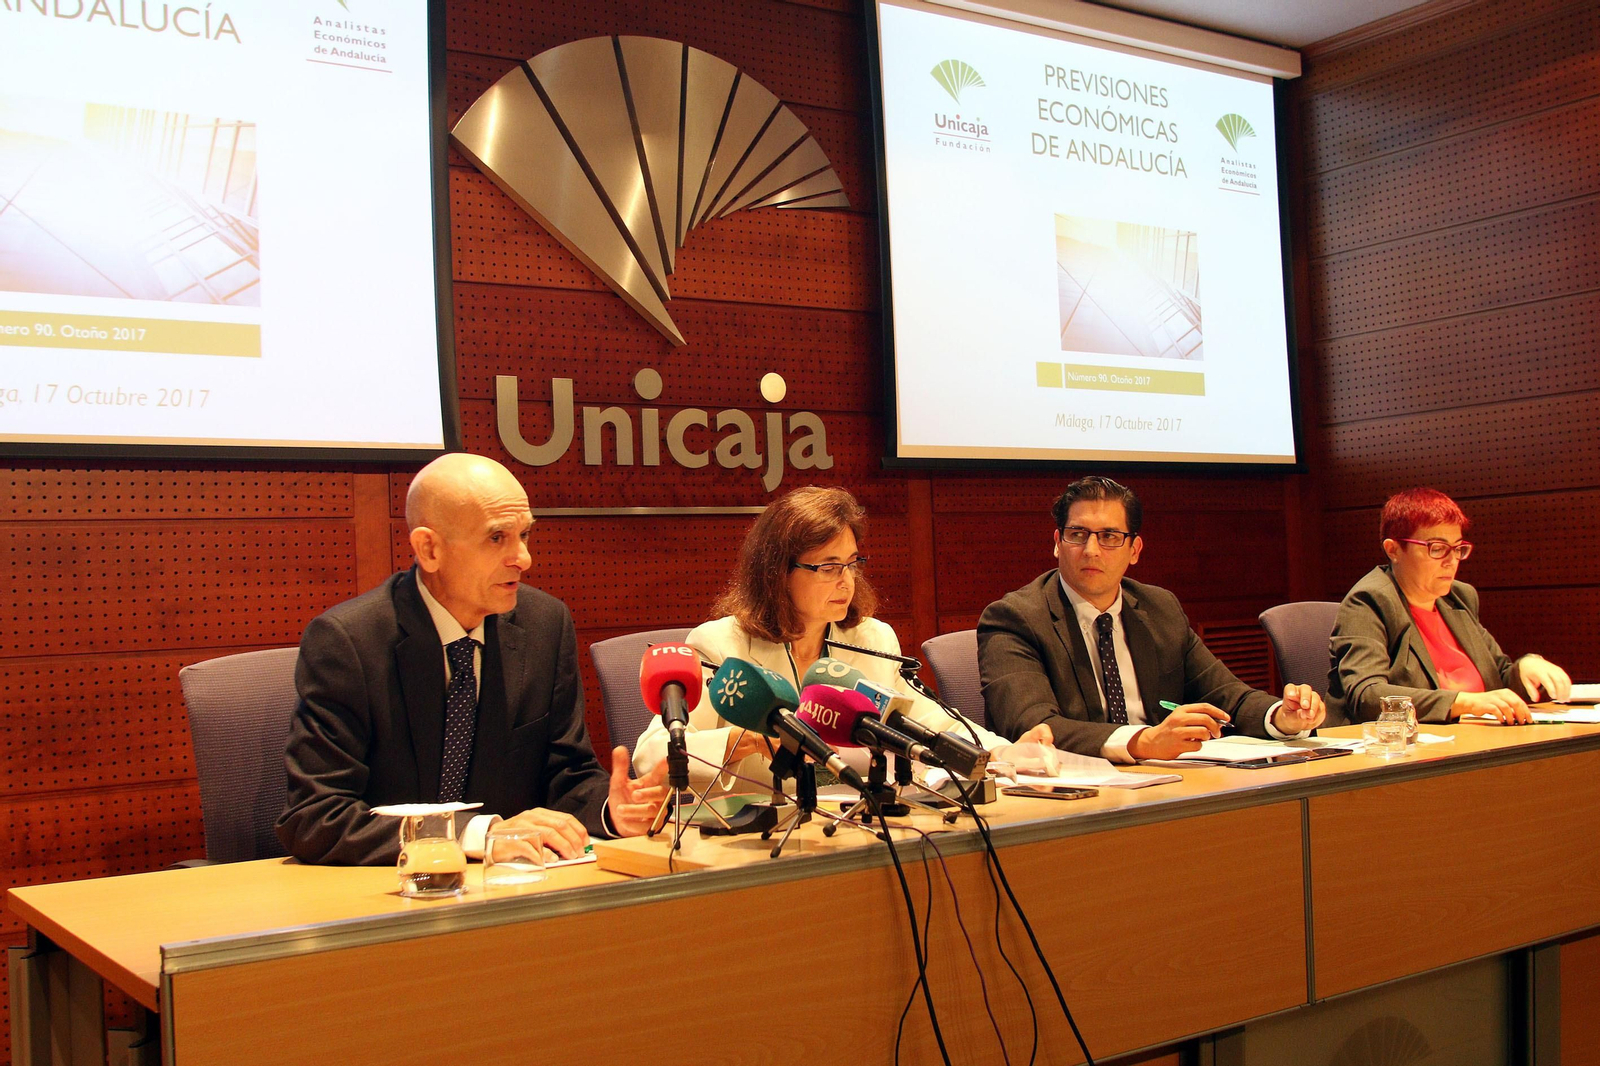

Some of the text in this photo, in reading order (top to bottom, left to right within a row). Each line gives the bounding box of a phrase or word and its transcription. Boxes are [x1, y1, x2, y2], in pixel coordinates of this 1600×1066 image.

[313, 16, 386, 35] Analistas
[313, 30, 386, 49] Económicos
[313, 45, 386, 63] de Andalucía
[1044, 64, 1169, 109] PREVISIONES
[934, 113, 989, 138] Unicaja
[1038, 98, 1179, 144] ECONÓMICAS
[935, 137, 991, 153] Fundación
[1031, 132, 1188, 179] DE ANDALUCÍA
[1221, 157, 1256, 169] Analistas
[1221, 167, 1257, 179] Económicos
[1230, 178, 1257, 189] Andalucía
[0, 323, 146, 341] ero 90. Otoño 2017
[1067, 371, 1150, 386] Número 90. Otoño 2017
[34, 383, 58, 403] 17
[67, 385, 148, 406] Octubre
[156, 388, 210, 408] 2017
[496, 368, 834, 493] Unicaja
[1055, 413, 1182, 432] Málaga, 17 Octubre 2017
[652, 646, 693, 657] rne
